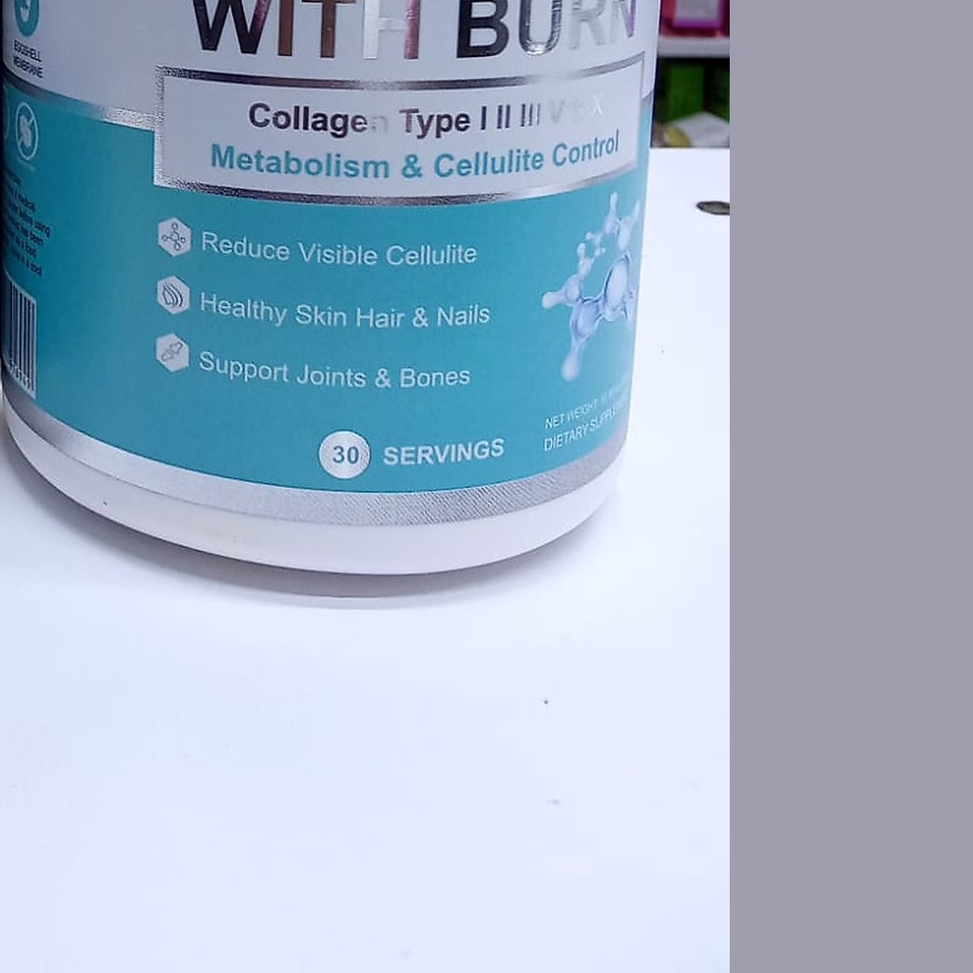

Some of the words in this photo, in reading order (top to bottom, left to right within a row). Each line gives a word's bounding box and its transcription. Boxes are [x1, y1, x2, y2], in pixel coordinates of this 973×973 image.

[248, 102, 390, 140] Collagen
[398, 107, 471, 140] Type
[210, 142, 391, 180] Metabolism
[401, 154, 424, 180] &
[433, 148, 545, 179] Cellulite
[551, 129, 620, 167] Control
[201, 231, 291, 263] Reduce
[299, 242, 378, 266] Visible
[385, 244, 478, 267] Cellulite
[199, 291, 288, 326] Healthy
[295, 303, 347, 328] Skin
[355, 306, 405, 329] Hair
[412, 306, 429, 328] &
[436, 303, 491, 326] Nails
[198, 350, 289, 384] Support
[295, 364, 367, 389] Joints
[374, 367, 391, 389] &
[399, 365, 471, 388] Bones
[544, 425, 588, 452] DIETARY
[545, 413, 565, 429] NET
[331, 445, 360, 465] 30
[383, 439, 506, 467] SERVINGS
